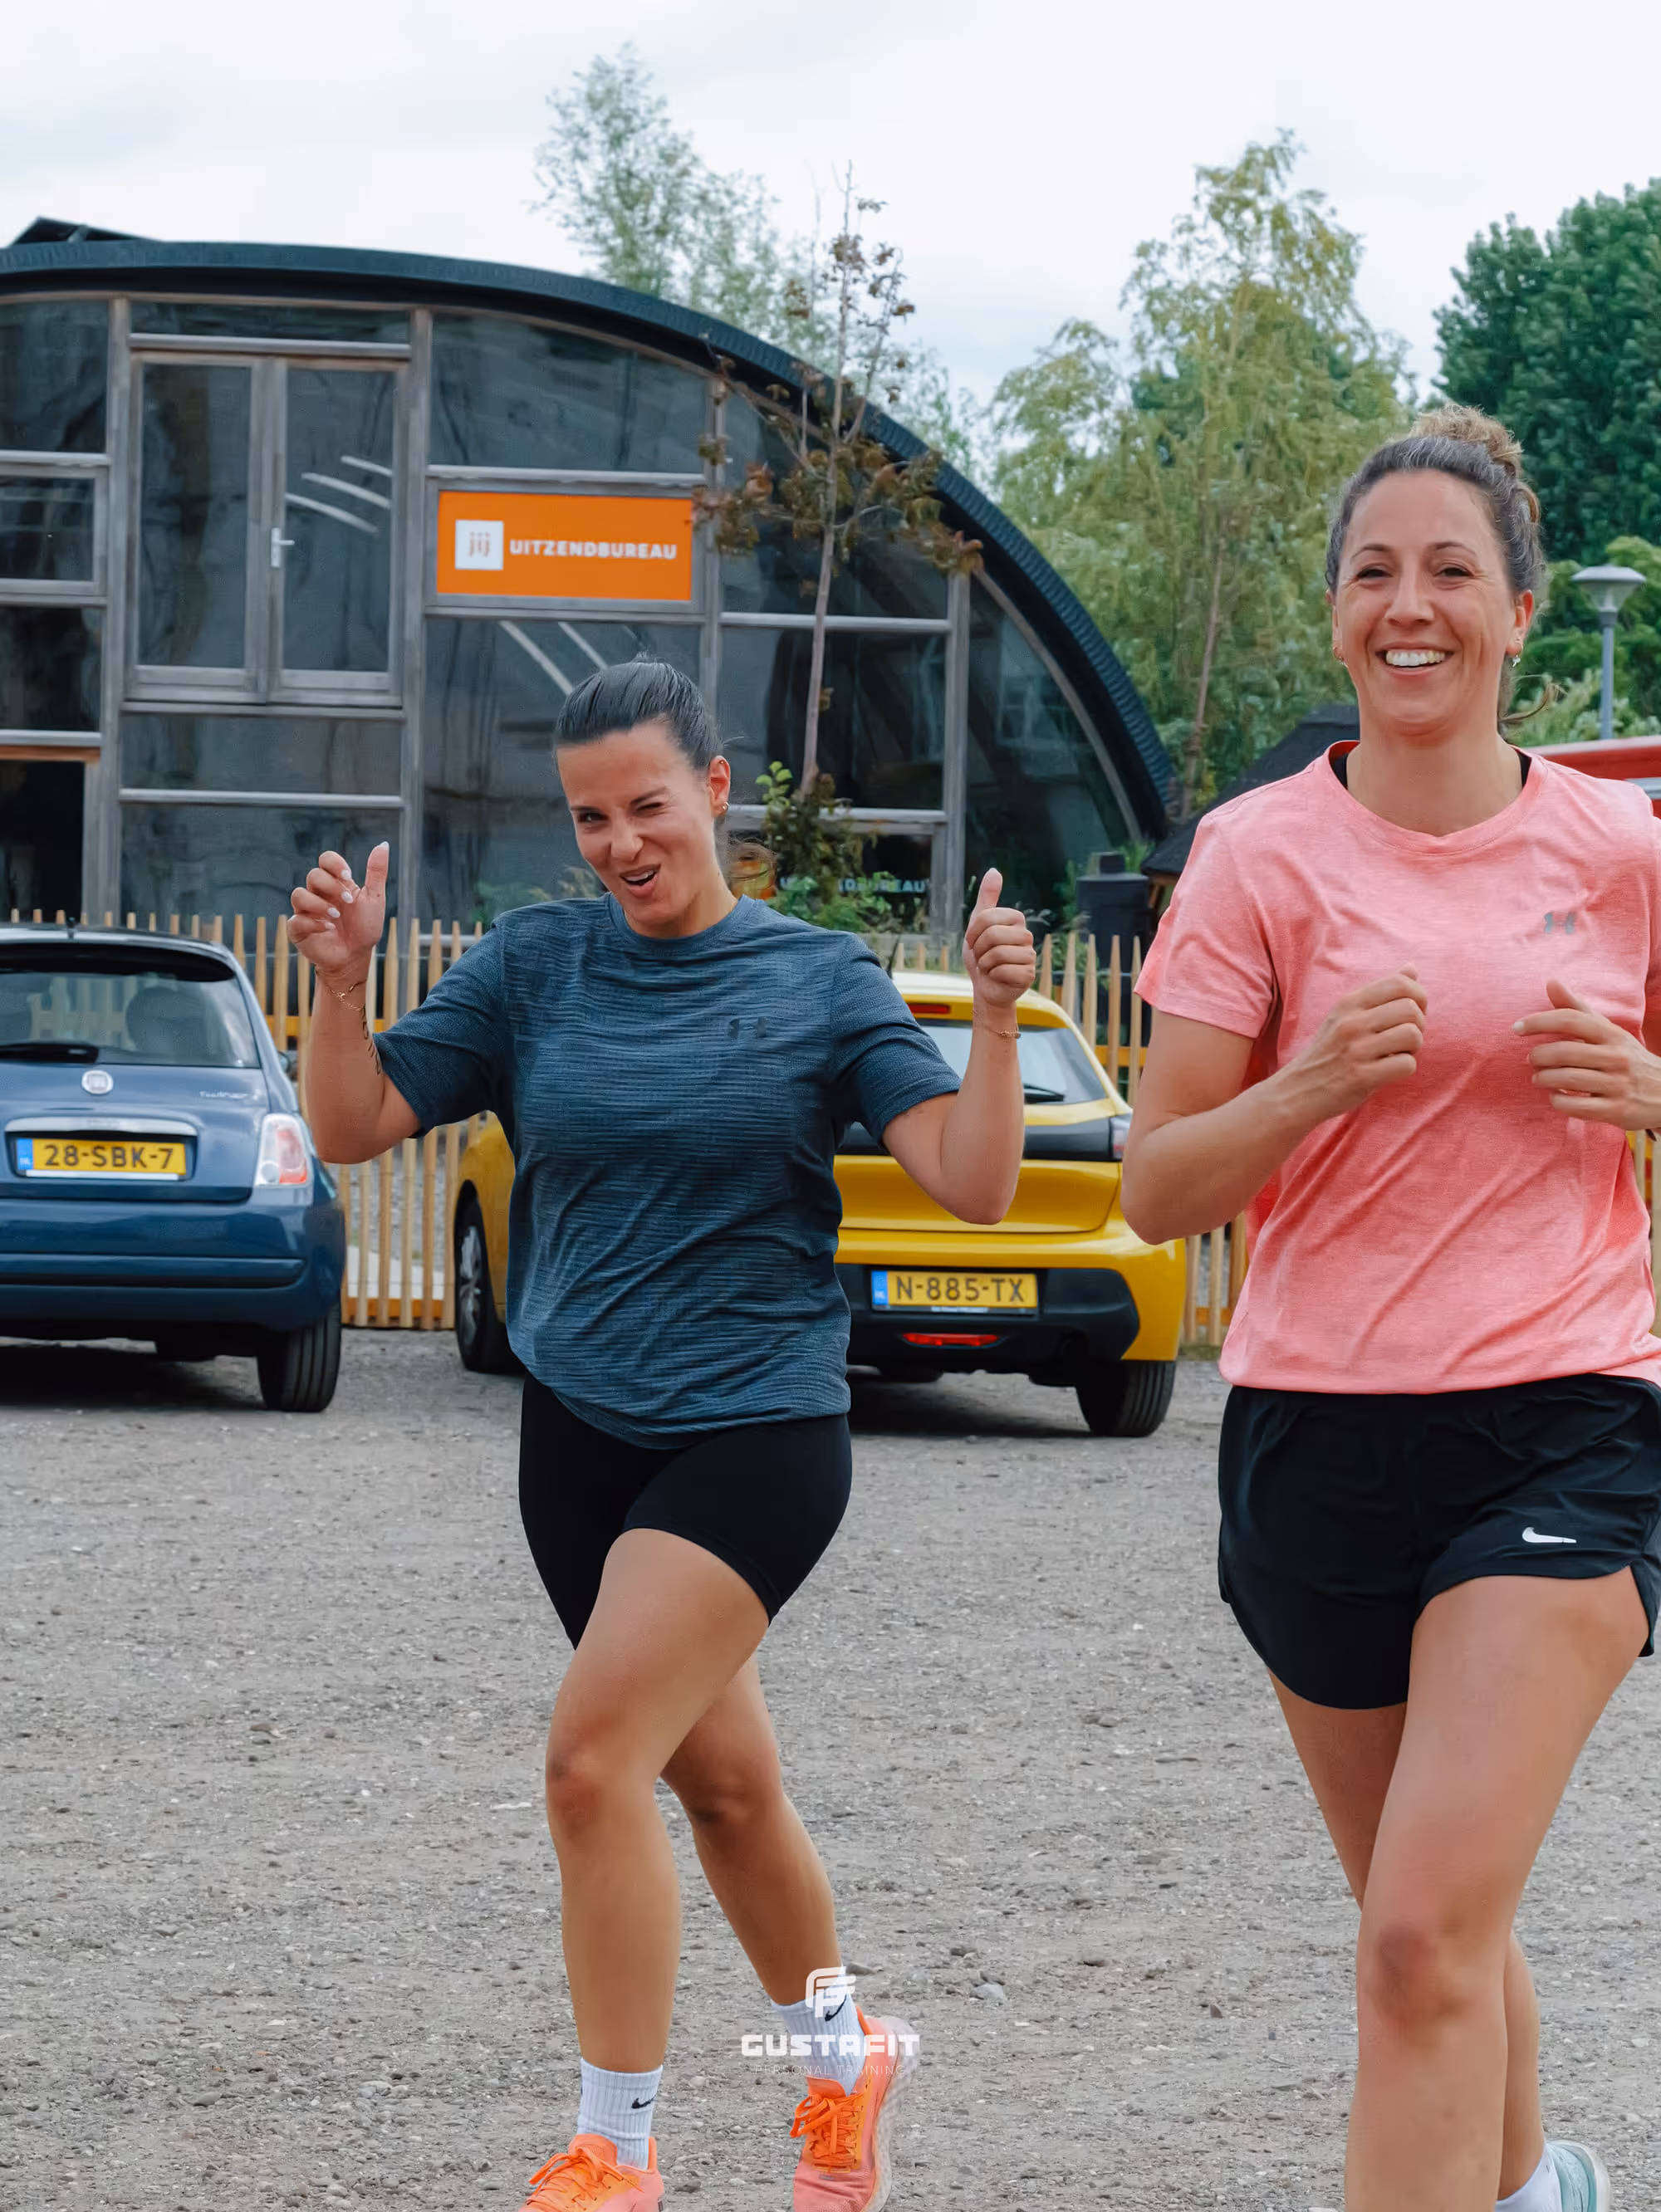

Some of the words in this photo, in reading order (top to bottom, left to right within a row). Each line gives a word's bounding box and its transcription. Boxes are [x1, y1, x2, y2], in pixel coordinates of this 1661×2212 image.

[509, 538, 678, 560] UITZENDBUREAU
[44, 1143, 174, 1170] 28-SBK-7
[895, 1275, 1025, 1303] N-885-TX
